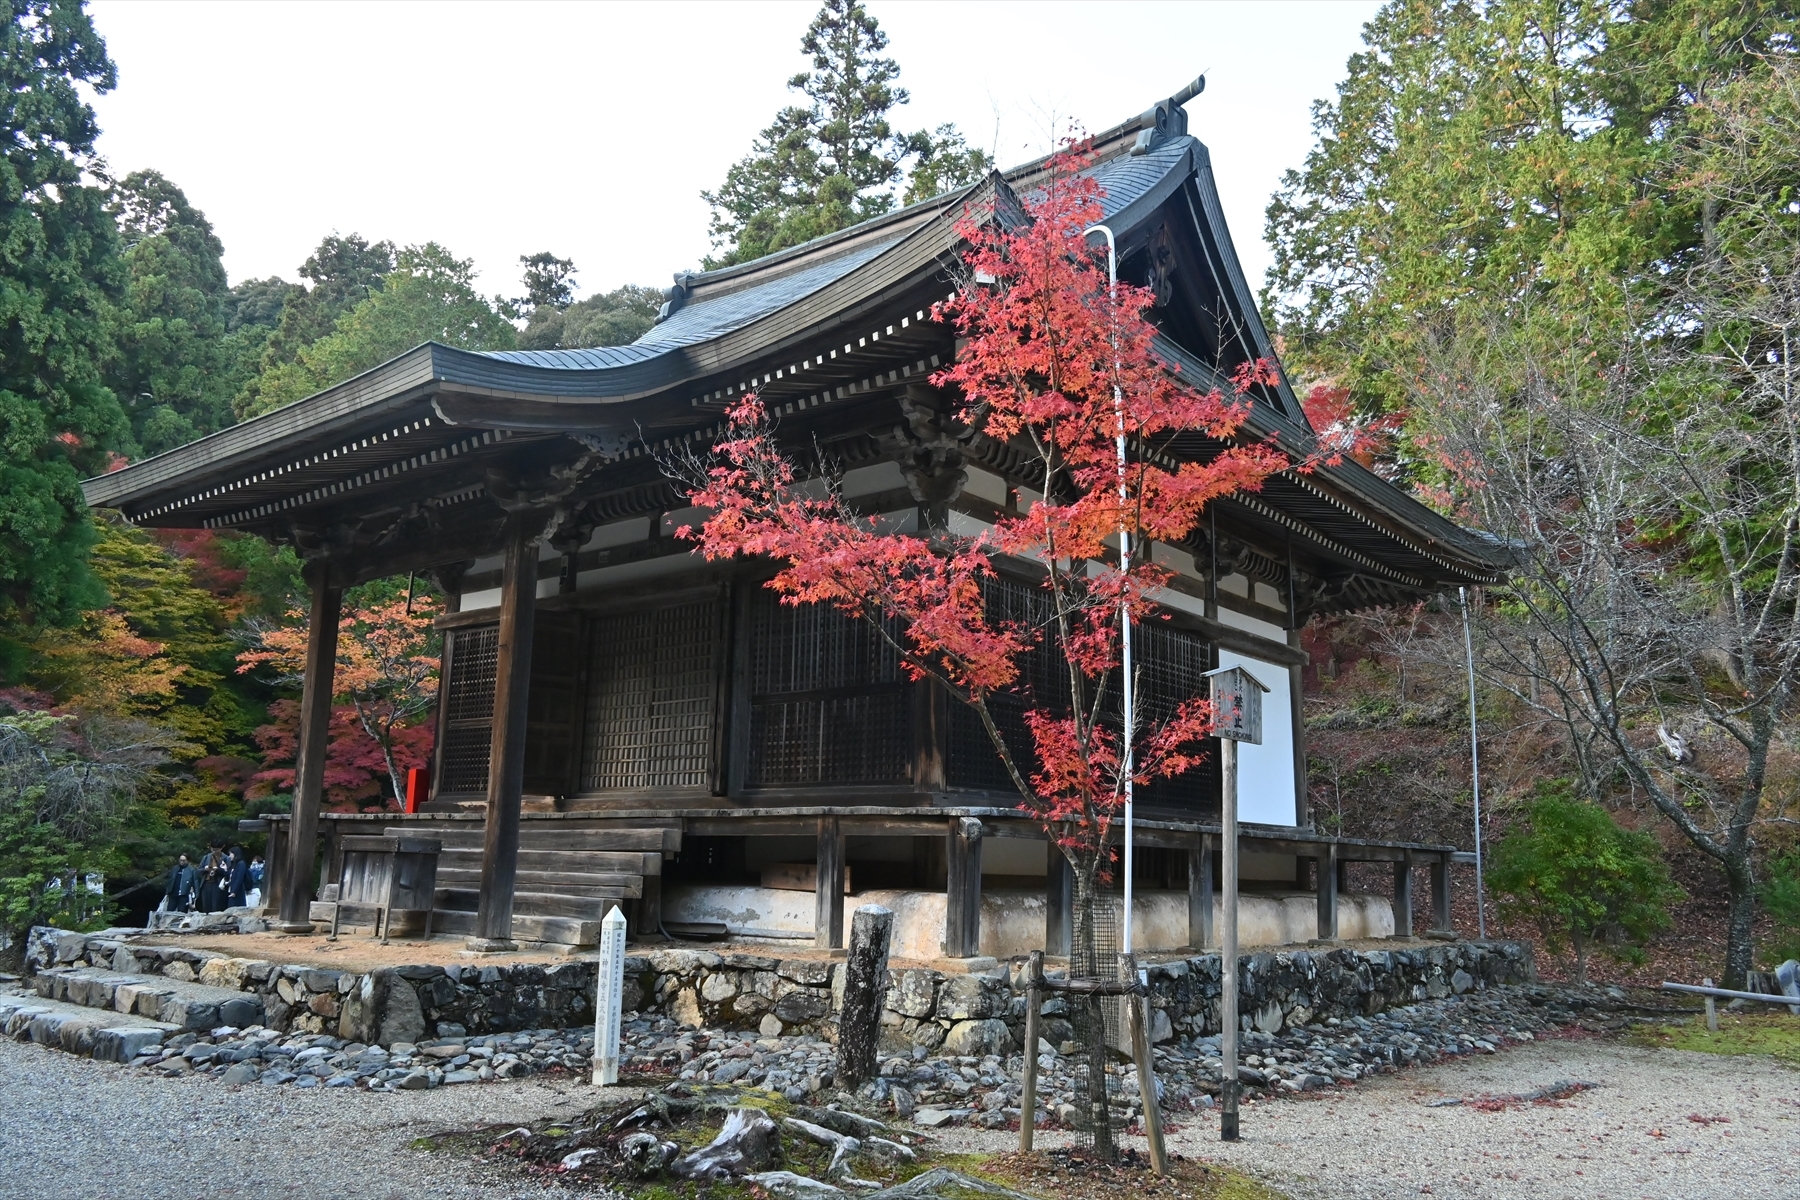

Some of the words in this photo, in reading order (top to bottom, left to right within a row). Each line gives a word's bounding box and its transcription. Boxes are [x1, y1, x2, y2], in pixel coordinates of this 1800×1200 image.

[1234, 694, 1243, 729] 禁止
[1224, 729, 1231, 737] NO
[1233, 731, 1252, 740] SMOKING
